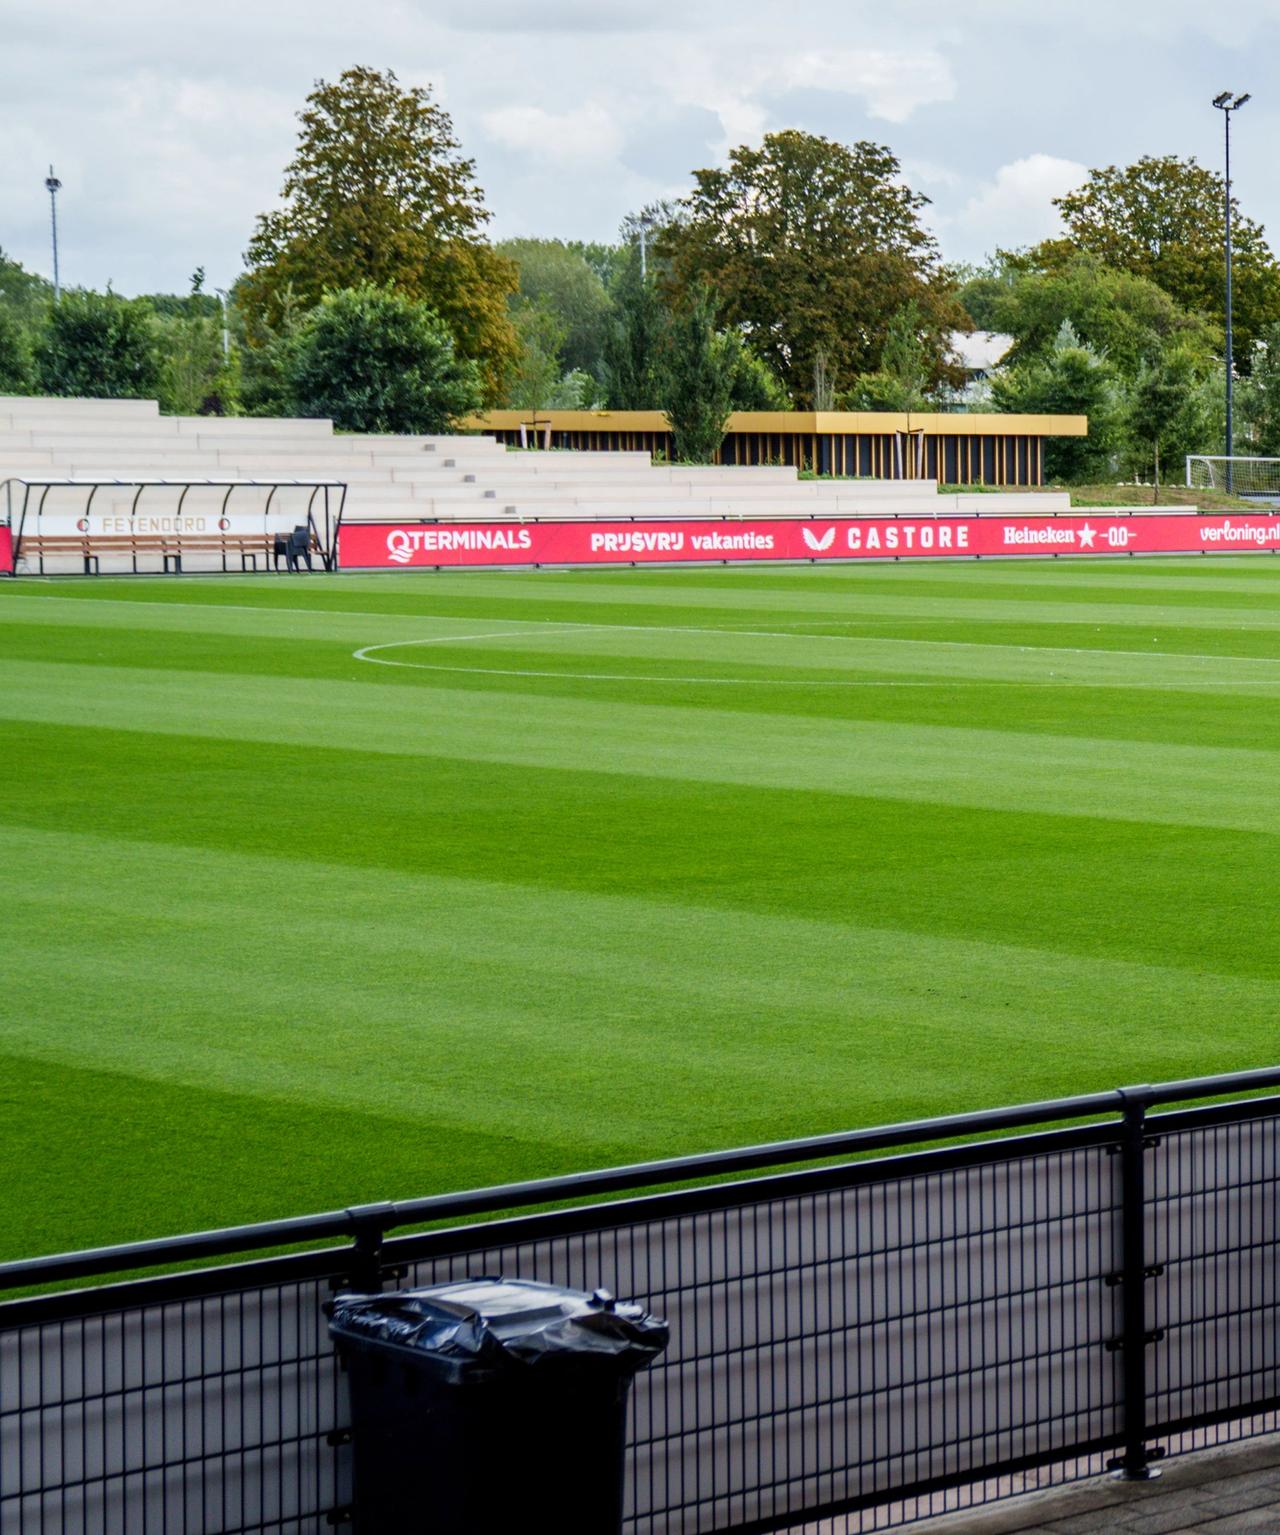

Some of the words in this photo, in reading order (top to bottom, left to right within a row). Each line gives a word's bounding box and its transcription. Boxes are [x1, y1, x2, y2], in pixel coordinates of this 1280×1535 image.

[102, 517, 206, 532] FEYENOORD
[1200, 520, 1280, 545] verloning.nl
[691, 531, 775, 549] vakanties
[847, 526, 969, 549] CASTORE
[1003, 526, 1075, 544] Heineken
